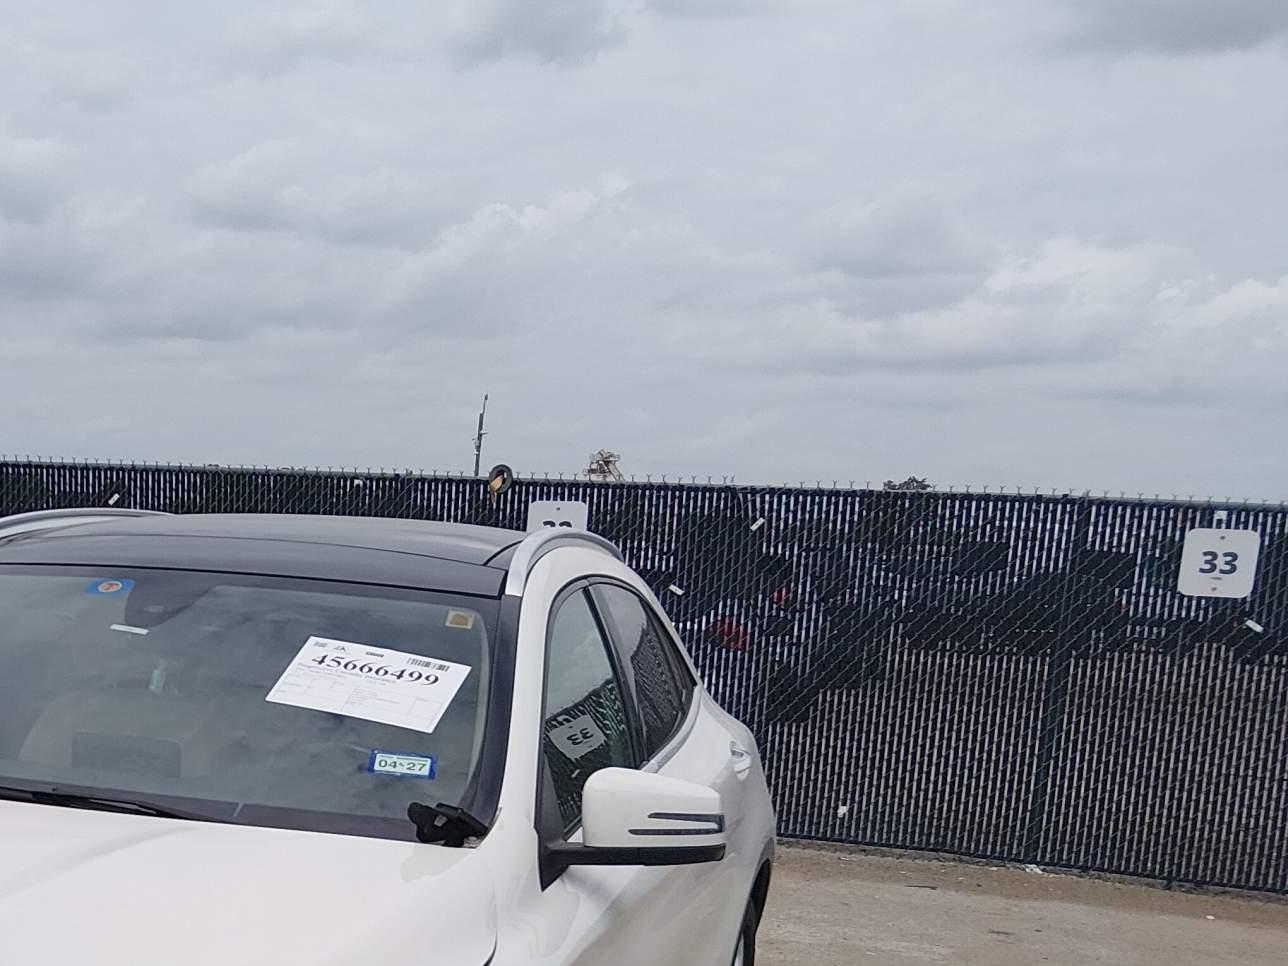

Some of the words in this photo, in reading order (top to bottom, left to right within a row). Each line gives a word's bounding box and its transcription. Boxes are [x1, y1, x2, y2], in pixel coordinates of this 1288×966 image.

[1198, 550, 1239, 575] 33
[311, 653, 439, 686] 45666499
[378, 759, 397, 769] 04
[406, 761, 427, 772] 27
